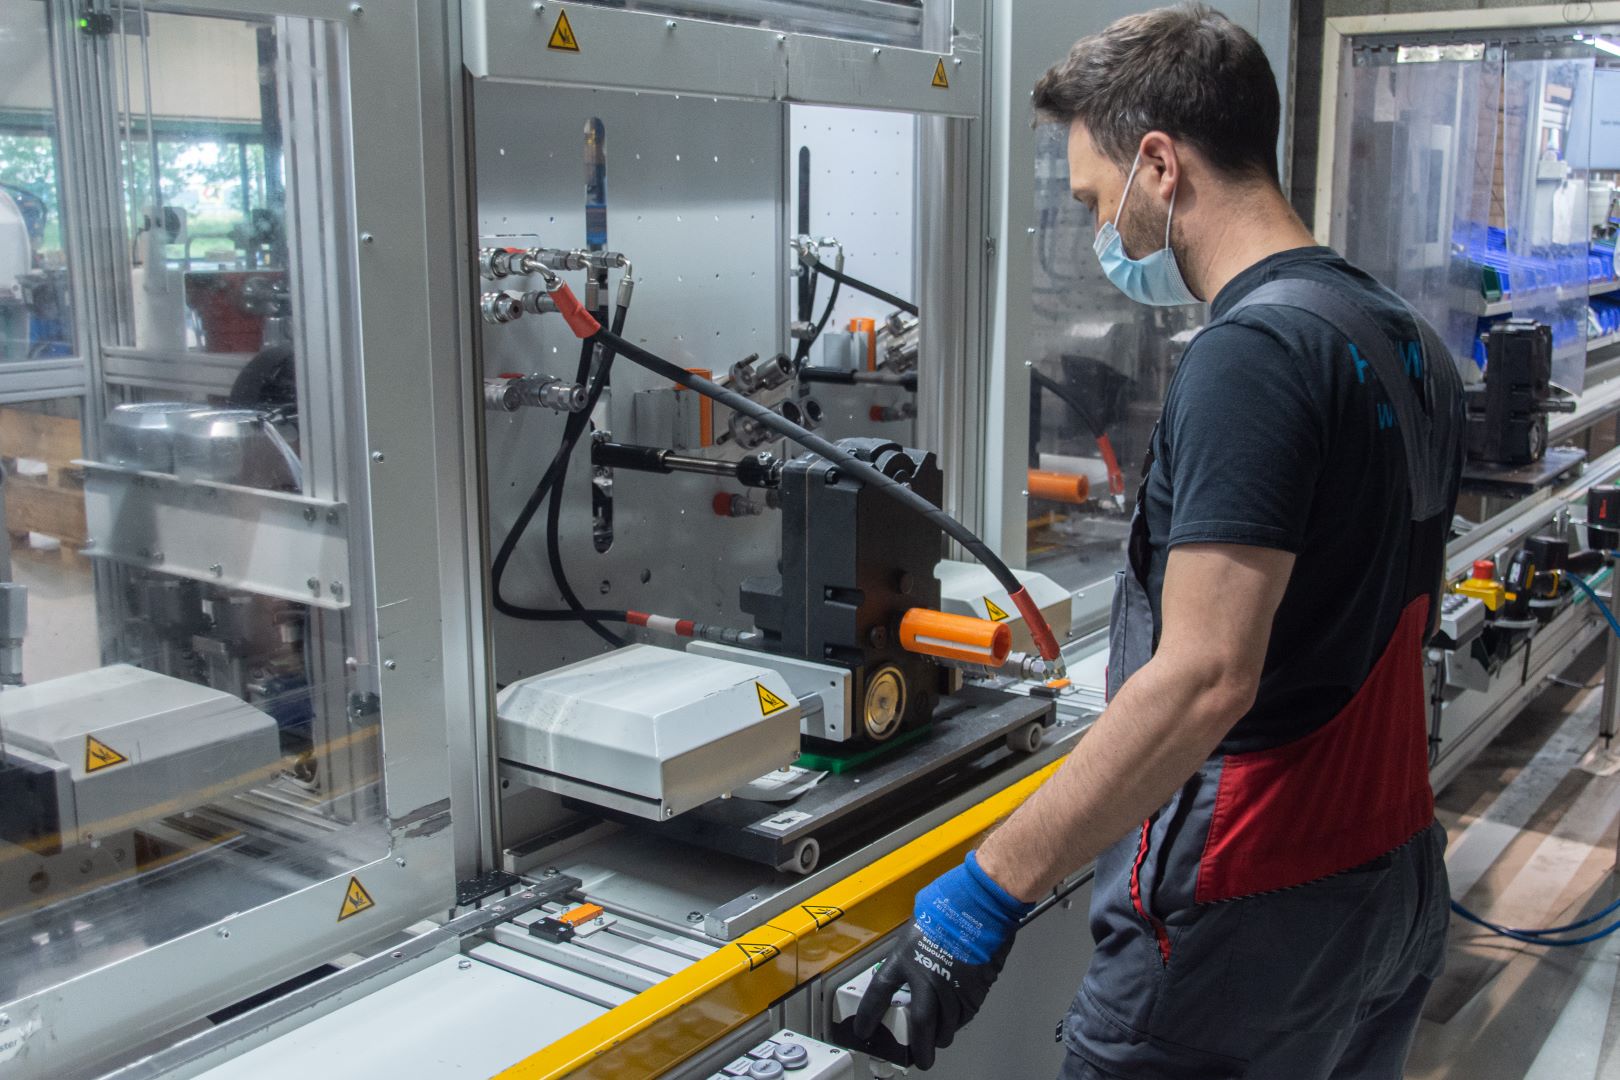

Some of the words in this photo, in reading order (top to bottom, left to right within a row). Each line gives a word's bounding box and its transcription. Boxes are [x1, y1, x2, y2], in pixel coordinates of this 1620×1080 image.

[922, 936, 939, 950] plus
[917, 940, 953, 967] phynomic
[940, 948, 953, 960] wet
[914, 949, 952, 981] uvex
